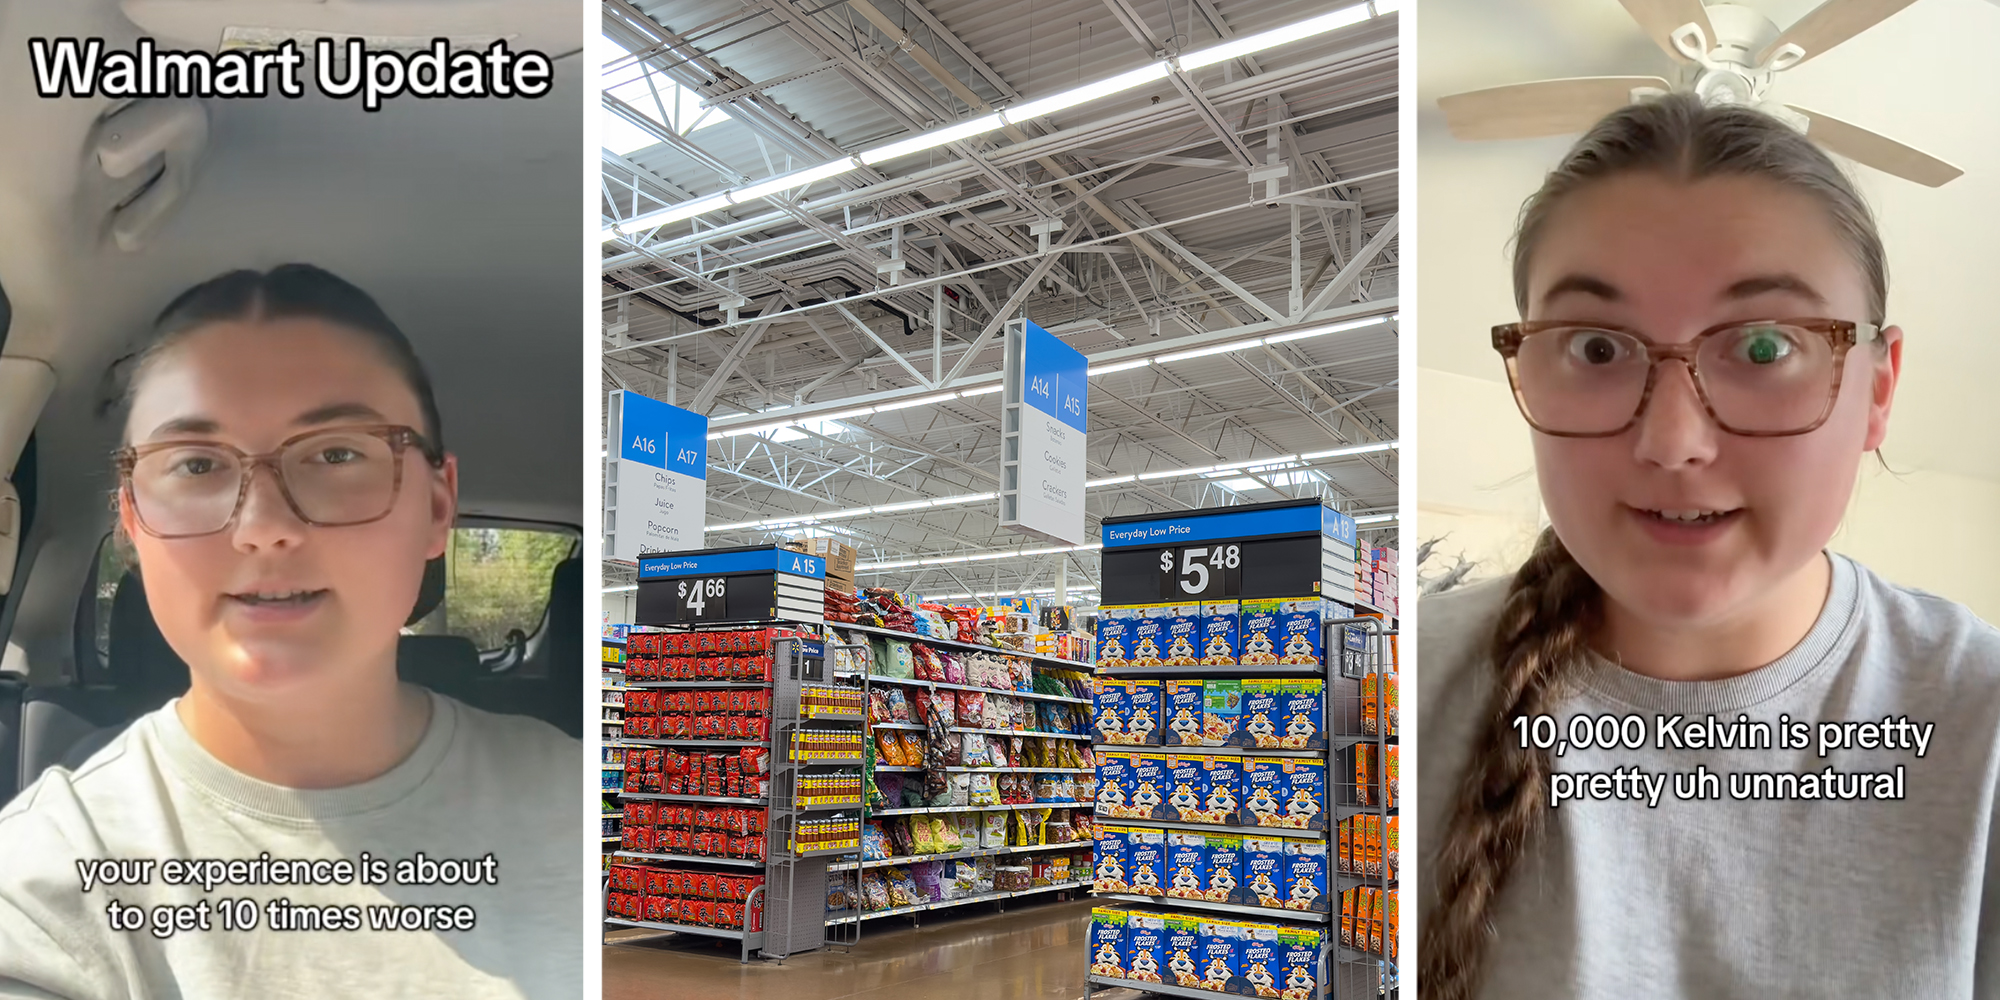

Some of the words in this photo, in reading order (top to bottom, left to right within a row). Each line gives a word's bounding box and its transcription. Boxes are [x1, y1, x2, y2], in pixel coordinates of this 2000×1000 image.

[1031, 376, 1049, 398] A14
[1064, 394, 1080, 416] A15
[1046, 421, 1066, 440] Snacks
[632, 436, 656, 454] A16
[677, 448, 698, 465] A17
[1044, 450, 1066, 470] Cookies
[655, 472, 676, 486] Chips
[1042, 480, 1067, 499] Crackers
[655, 498, 674, 509] Juice
[648, 520, 678, 535] Popcorn
[1110, 527, 1148, 540] Everyday
[1150, 526, 1167, 536] Low
[1169, 525, 1191, 534] Price
[645, 562, 669, 573] Everyday
[671, 562, 682, 570] Low
[683, 561, 698, 569] Price
[1170, 622, 1192, 630] FROSTED
[1248, 617, 1272, 625] FROSTED
[1248, 698, 1273, 706] FROSTED
[1288, 698, 1314, 706] FROSTED
[1210, 769, 1234, 777] FROSTED
